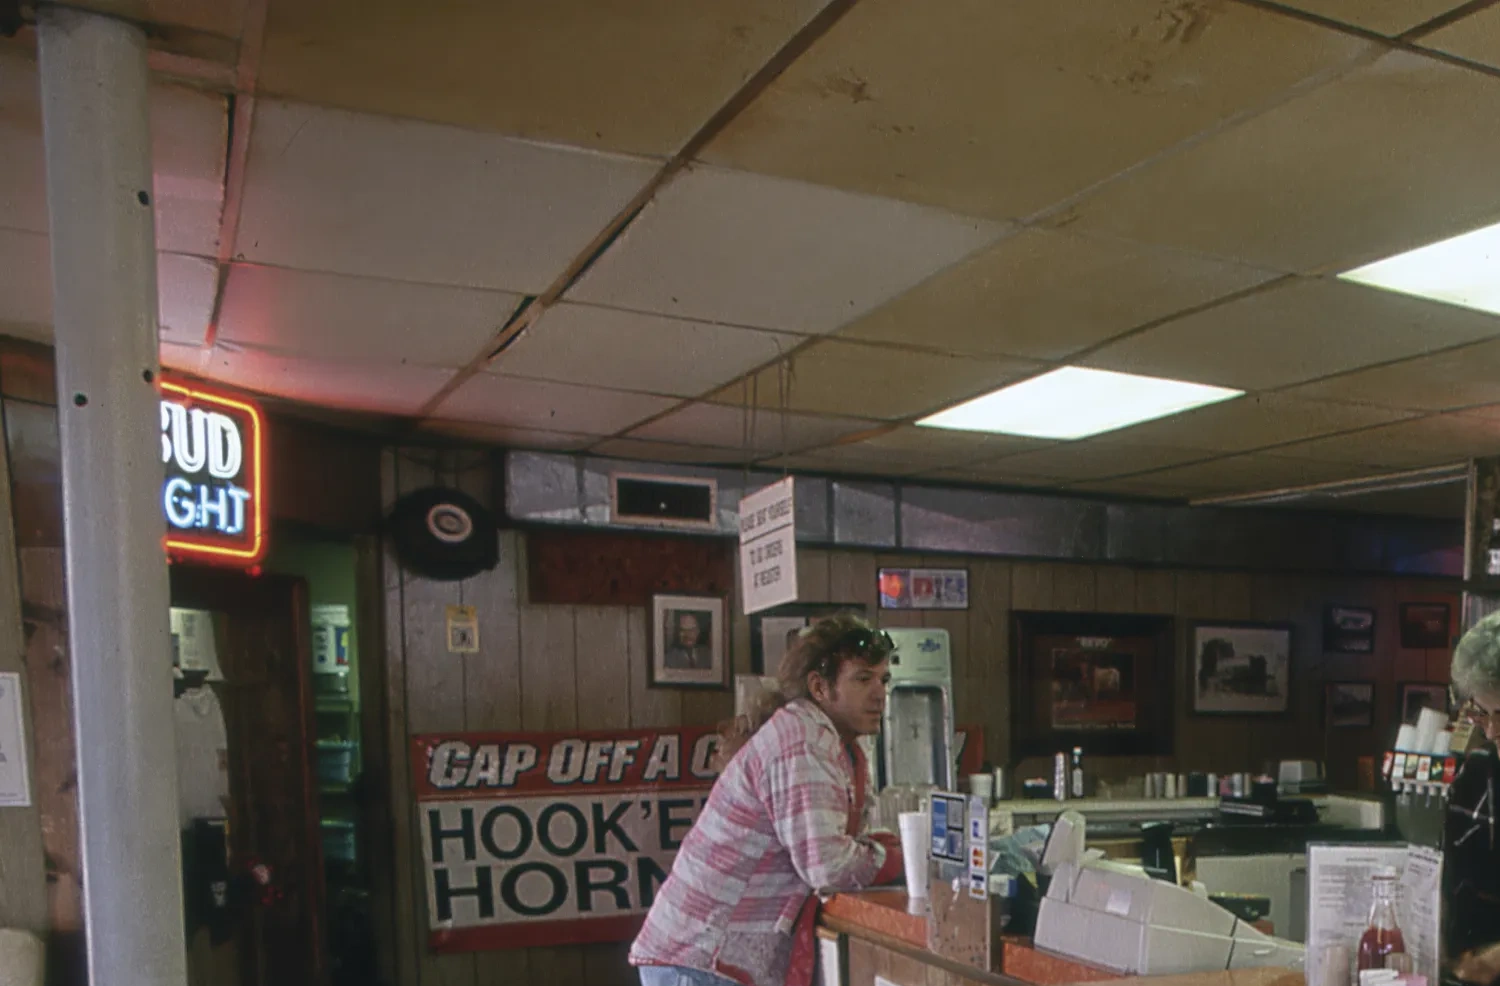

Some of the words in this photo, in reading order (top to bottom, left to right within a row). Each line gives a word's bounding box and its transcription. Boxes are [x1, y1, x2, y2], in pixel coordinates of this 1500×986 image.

[165, 478, 252, 534] GHT
[429, 740, 537, 789] CAP
[547, 738, 642, 783] OFF
[643, 734, 682, 781] A
[428, 799, 708, 862] HOOK'E
[433, 856, 671, 922] HORN
